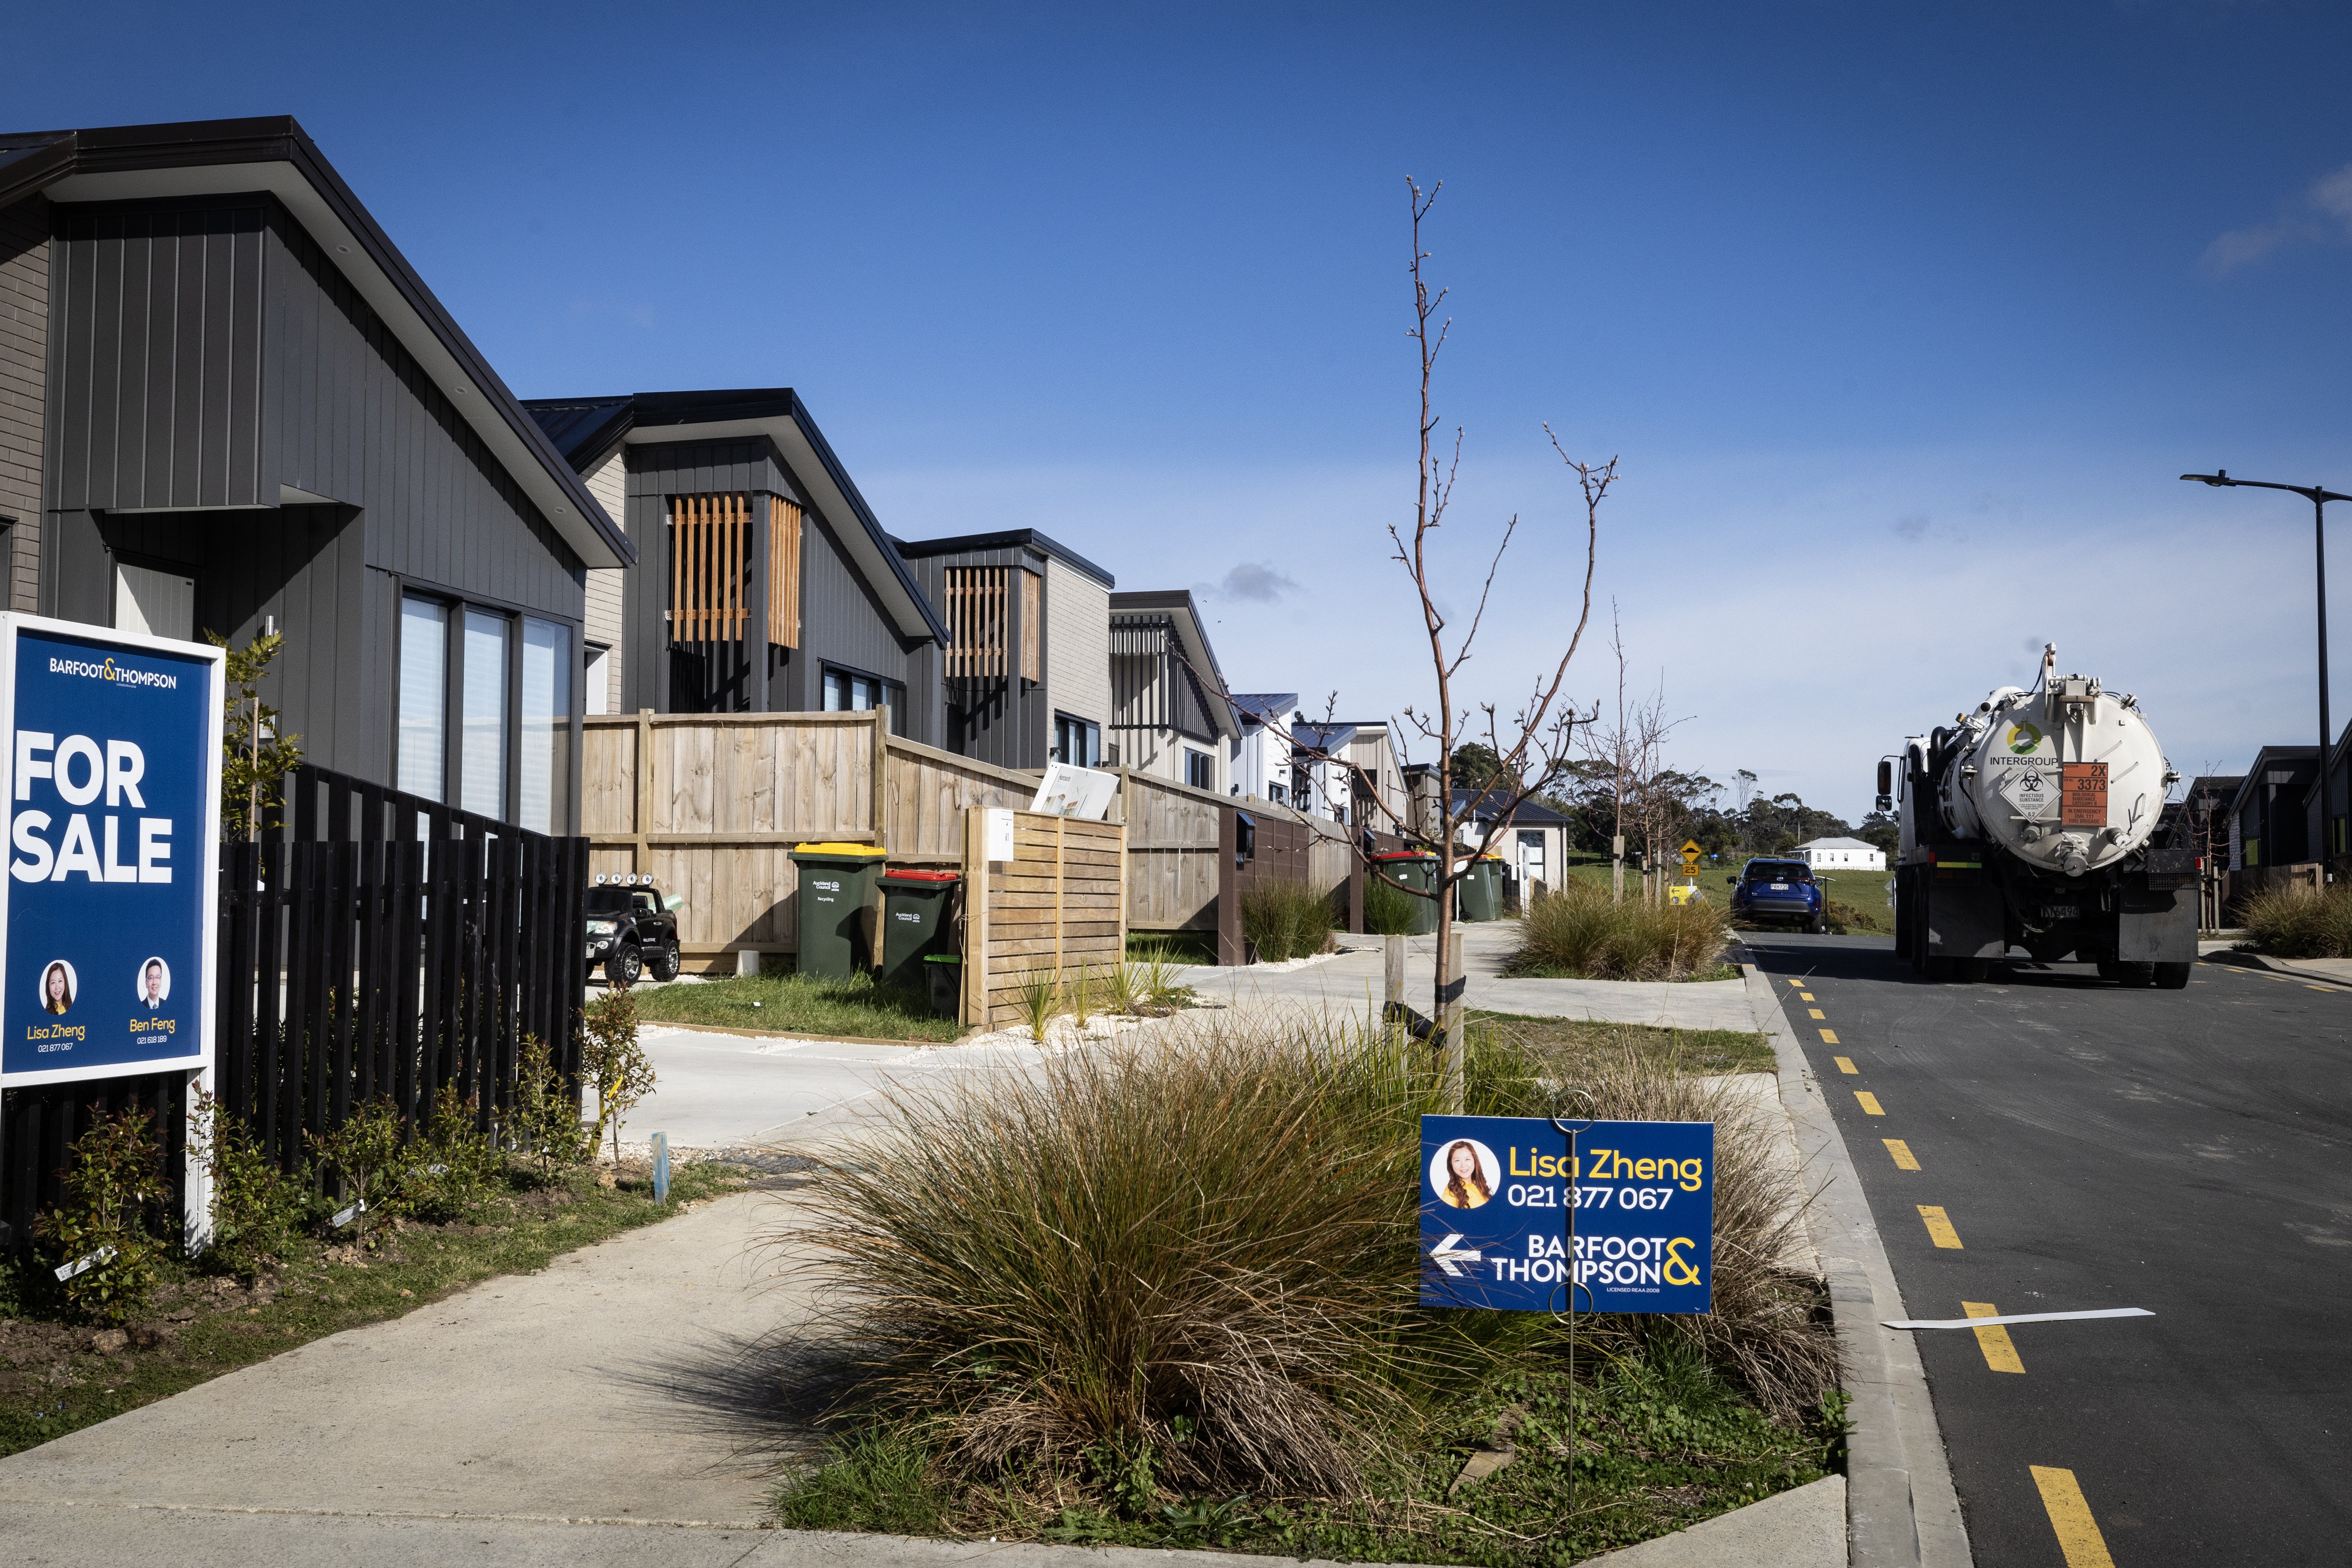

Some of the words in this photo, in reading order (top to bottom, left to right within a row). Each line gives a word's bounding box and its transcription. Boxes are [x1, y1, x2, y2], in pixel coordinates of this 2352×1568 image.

[15, 730, 146, 808] FOR
[1990, 757, 2058, 766] INTERGROUP
[2091, 765, 2106, 777] 2X
[2077, 779, 2106, 791] 3373
[10, 810, 172, 883] SALE
[27, 1026, 49, 1039] Lisa
[51, 1024, 85, 1041] Zheng
[130, 1019, 149, 1032] Ben
[151, 1017, 175, 1033] Feng
[38, 1044, 49, 1053] 021
[50, 1044, 61, 1052] 877
[1509, 1146, 1579, 1178] Lisa
[1588, 1149, 1702, 1192] Zheng
[1507, 1184, 1557, 1207] 021
[1563, 1187, 1614, 1209] 877
[1619, 1188, 1674, 1210] 067
[1529, 1235, 1667, 1260] BARFOOT
[1490, 1258, 1661, 1285] THOMPSON
